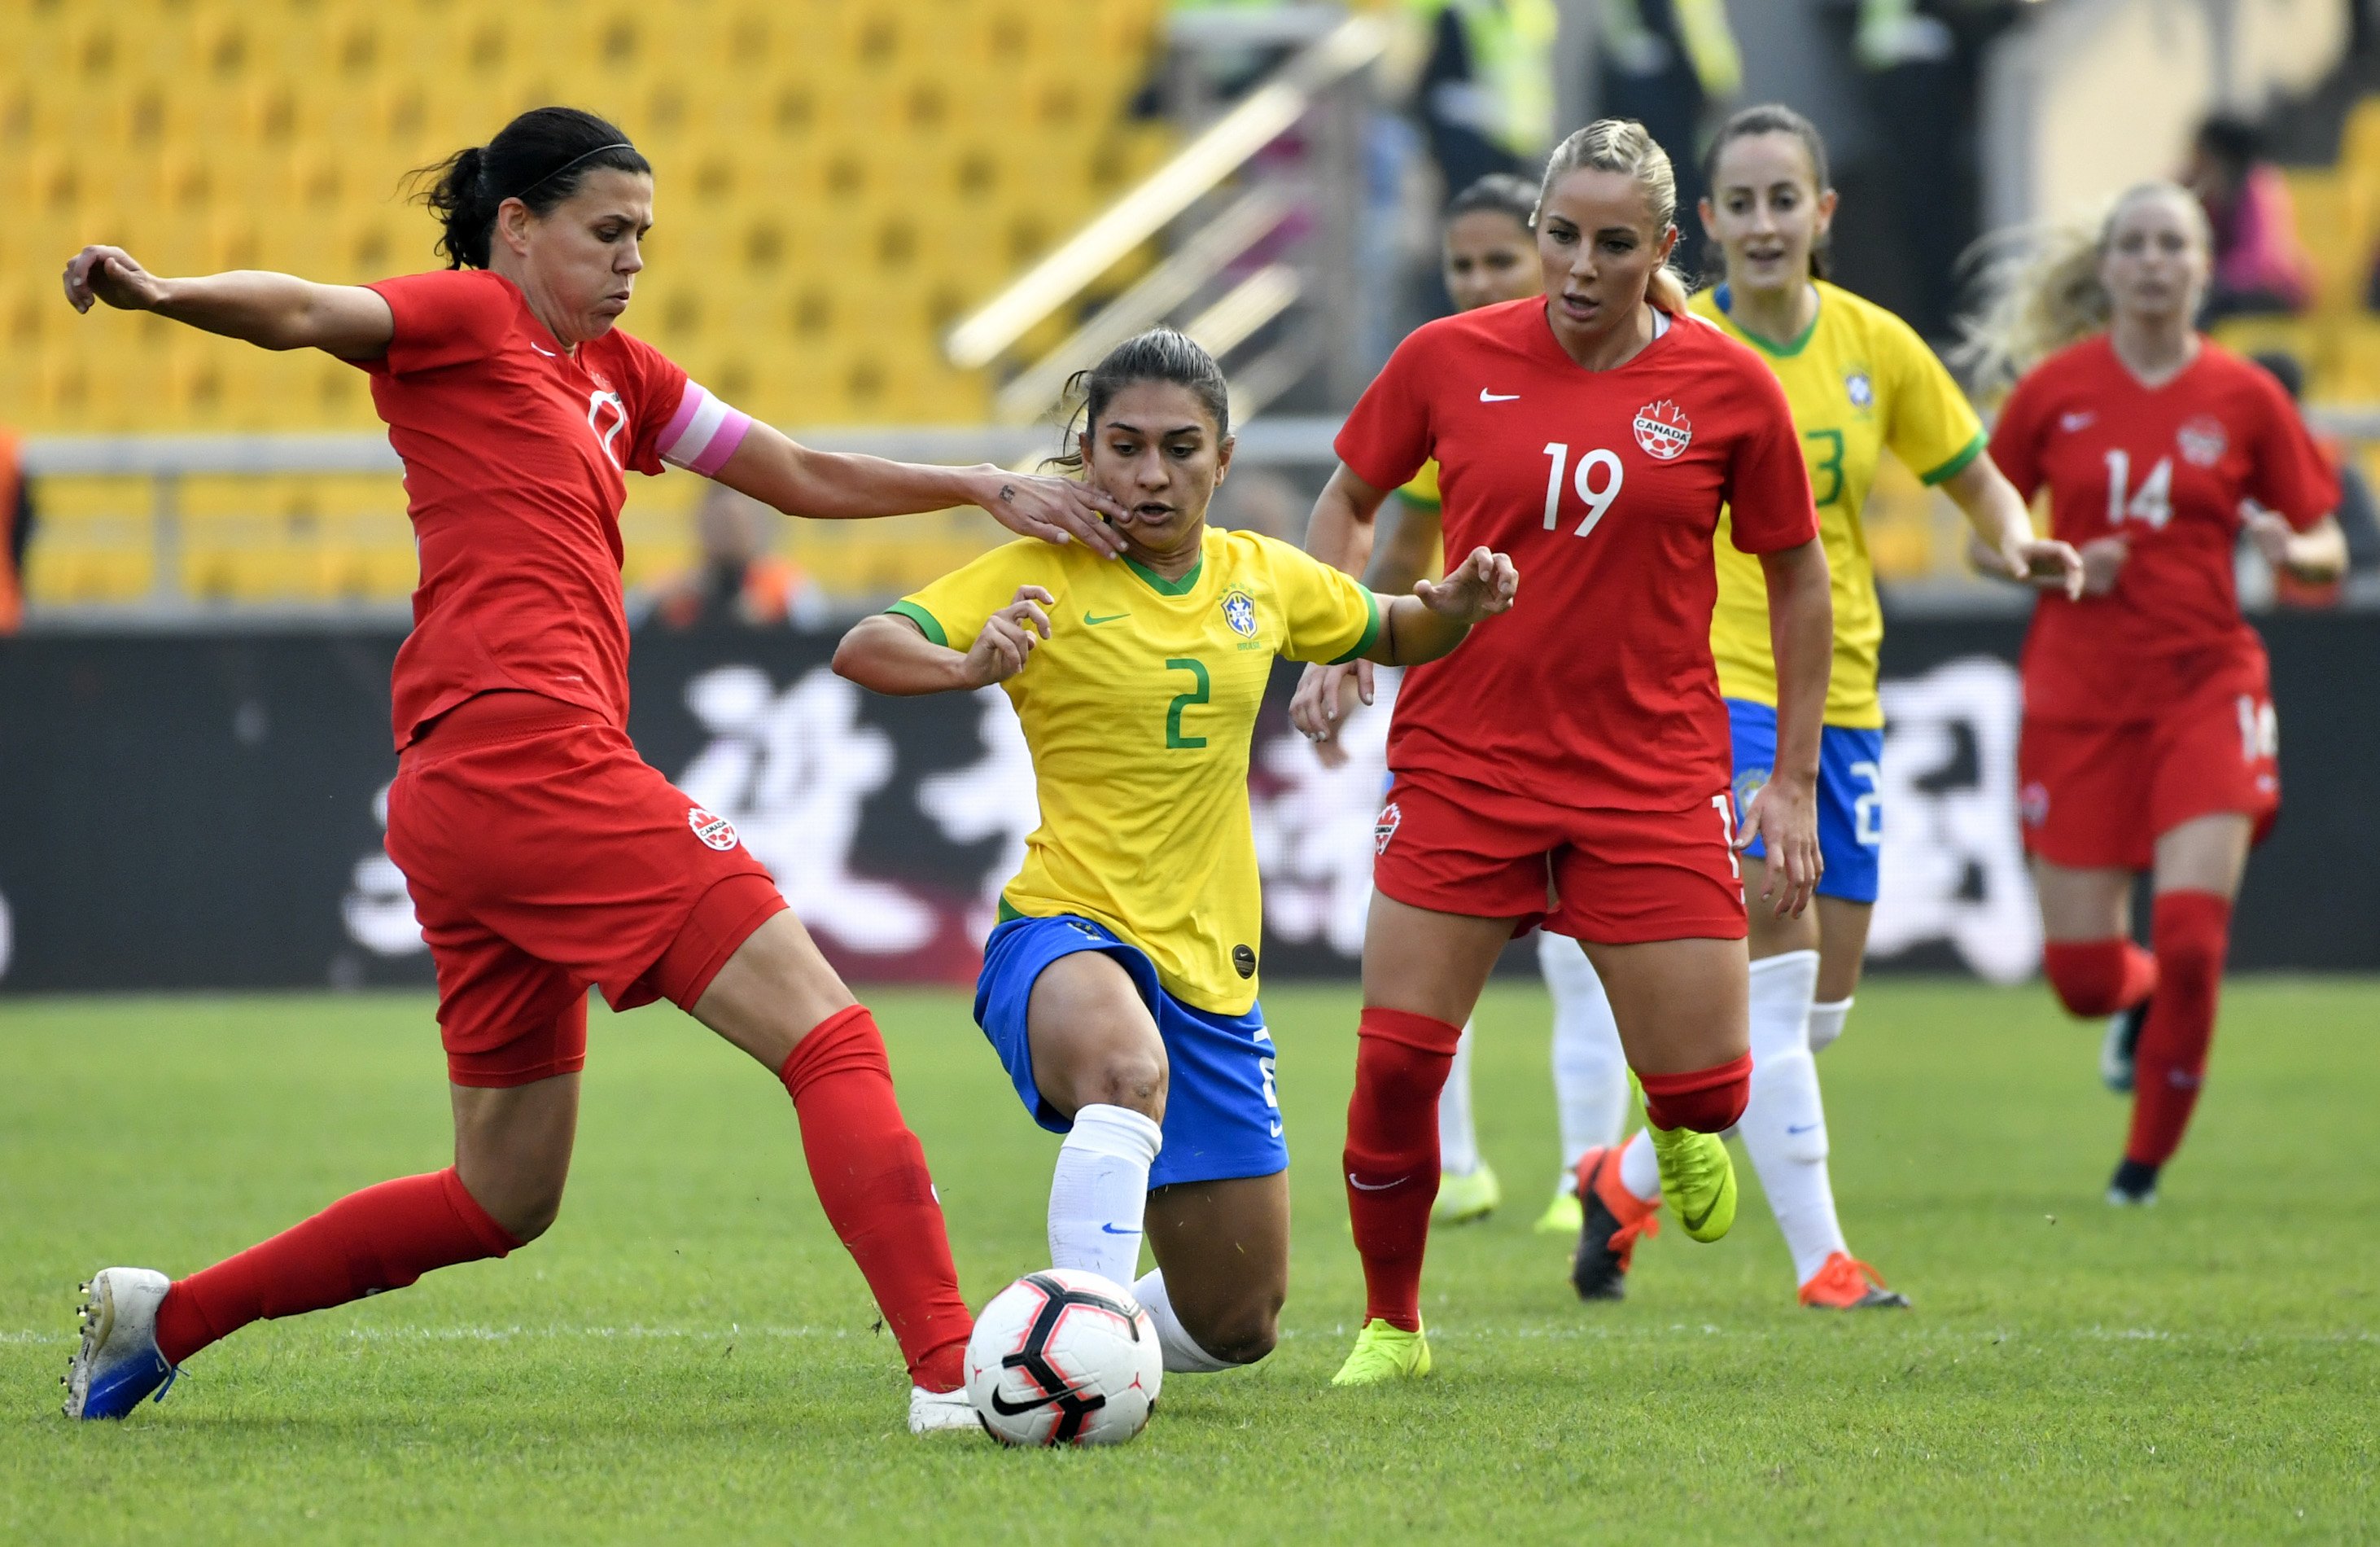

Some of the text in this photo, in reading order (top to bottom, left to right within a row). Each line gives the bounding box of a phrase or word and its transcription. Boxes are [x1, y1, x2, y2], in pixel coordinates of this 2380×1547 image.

[1635, 419, 1688, 443] CANADA
[1542, 442, 1624, 537] 19
[2103, 449, 2173, 532] 14
[1166, 658, 1210, 749] 2
[699, 820, 727, 836] CANADA
